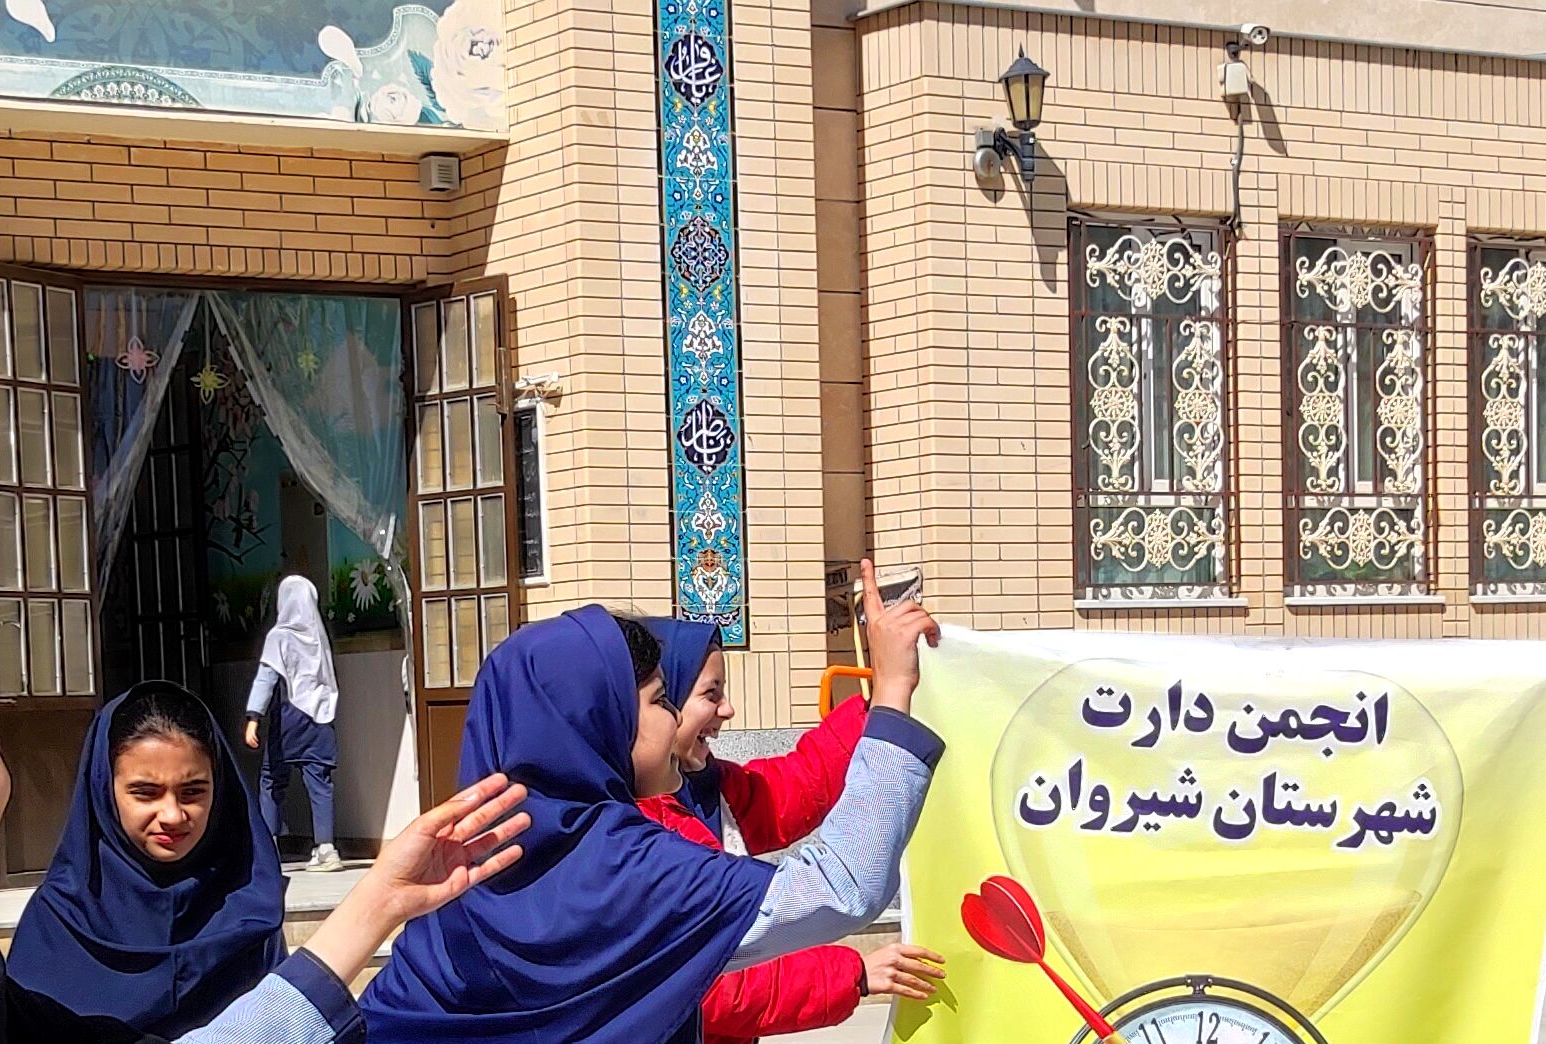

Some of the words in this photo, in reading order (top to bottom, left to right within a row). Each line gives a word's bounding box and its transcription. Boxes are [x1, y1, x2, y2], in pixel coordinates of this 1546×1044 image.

[1081, 680, 1214, 747] دارت
[1227, 690, 1390, 758] انجمن
[1018, 759, 1204, 833] شیروان
[1213, 771, 1438, 849] شهرستان
